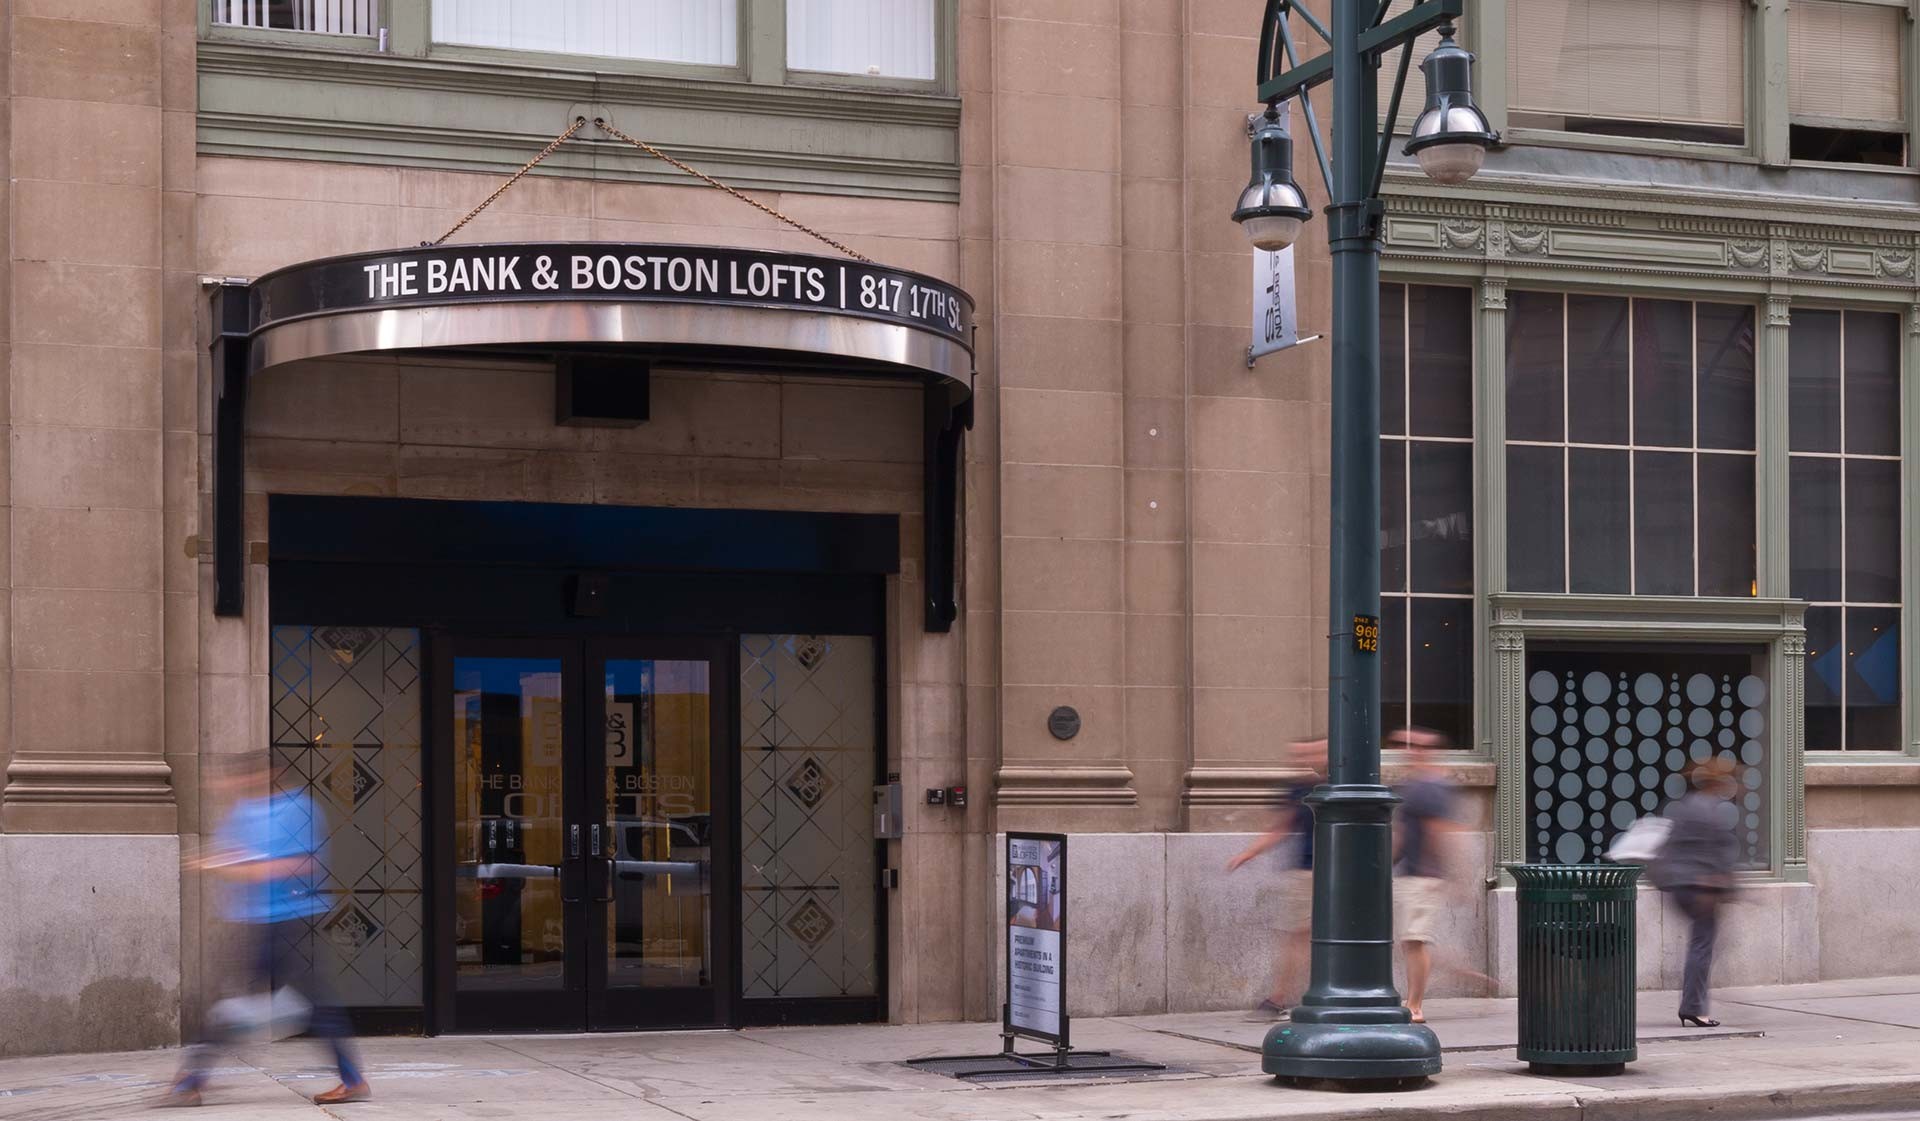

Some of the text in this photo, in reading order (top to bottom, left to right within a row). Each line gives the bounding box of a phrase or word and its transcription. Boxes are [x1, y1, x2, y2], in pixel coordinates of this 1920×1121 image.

[363, 261, 419, 300] THE
[427, 256, 522, 295] BANK
[531, 255, 560, 291] &
[571, 255, 718, 294] BOSTON
[730, 261, 826, 302] LOFTS
[860, 274, 904, 313] 817
[910, 284, 946, 320] 17TH
[1355, 624, 1378, 639] 960
[1357, 638, 1377, 652] 142
[509, 773, 561, 790] BANK
[625, 774, 695, 790] BOSTON
